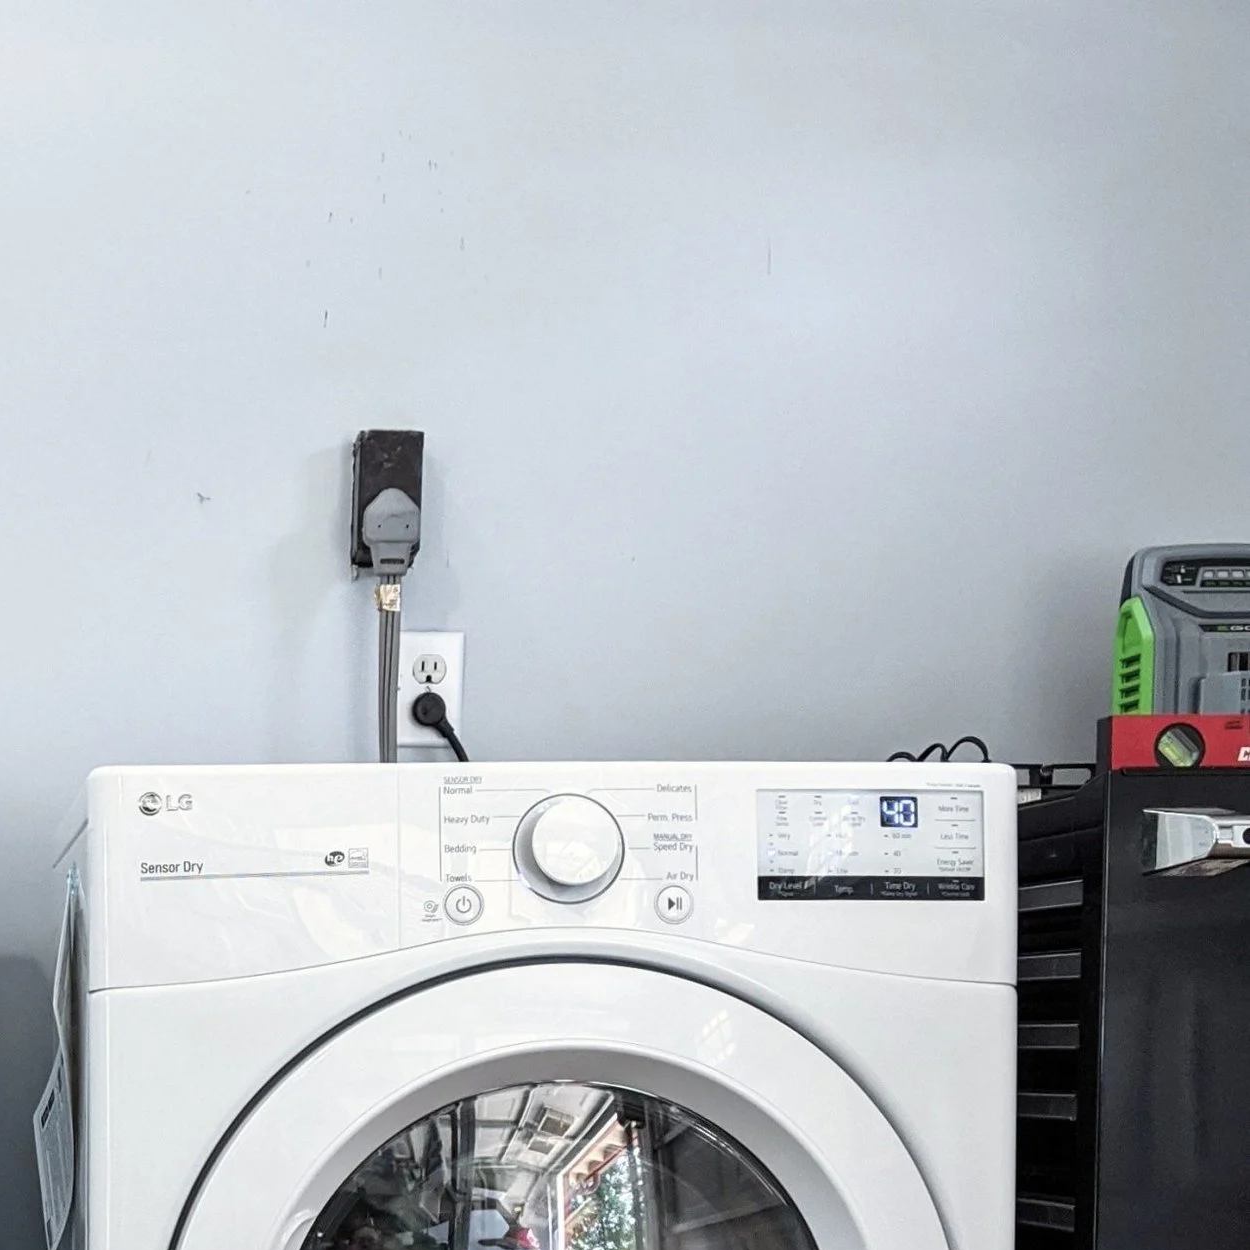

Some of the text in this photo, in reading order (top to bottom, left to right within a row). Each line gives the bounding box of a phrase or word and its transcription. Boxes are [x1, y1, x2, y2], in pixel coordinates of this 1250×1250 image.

[443, 775, 482, 783] SENSOR DRY
[443, 786, 473, 794] Normal
[656, 784, 692, 793] Delicates
[166, 793, 193, 811] LG
[882, 799, 915, 826] 40
[955, 805, 969, 813] Time
[443, 815, 490, 825] Heavy Duty
[647, 813, 693, 822] Perm. Press
[444, 845, 477, 855] Bedding
[653, 842, 694, 852] Speed Dry
[140, 860, 204, 875] Sensor Dry
[446, 873, 472, 882] Towels
[667, 872, 694, 883] Air Dry
[769, 882, 782, 892] Dry
[885, 882, 917, 892] Time Dry
